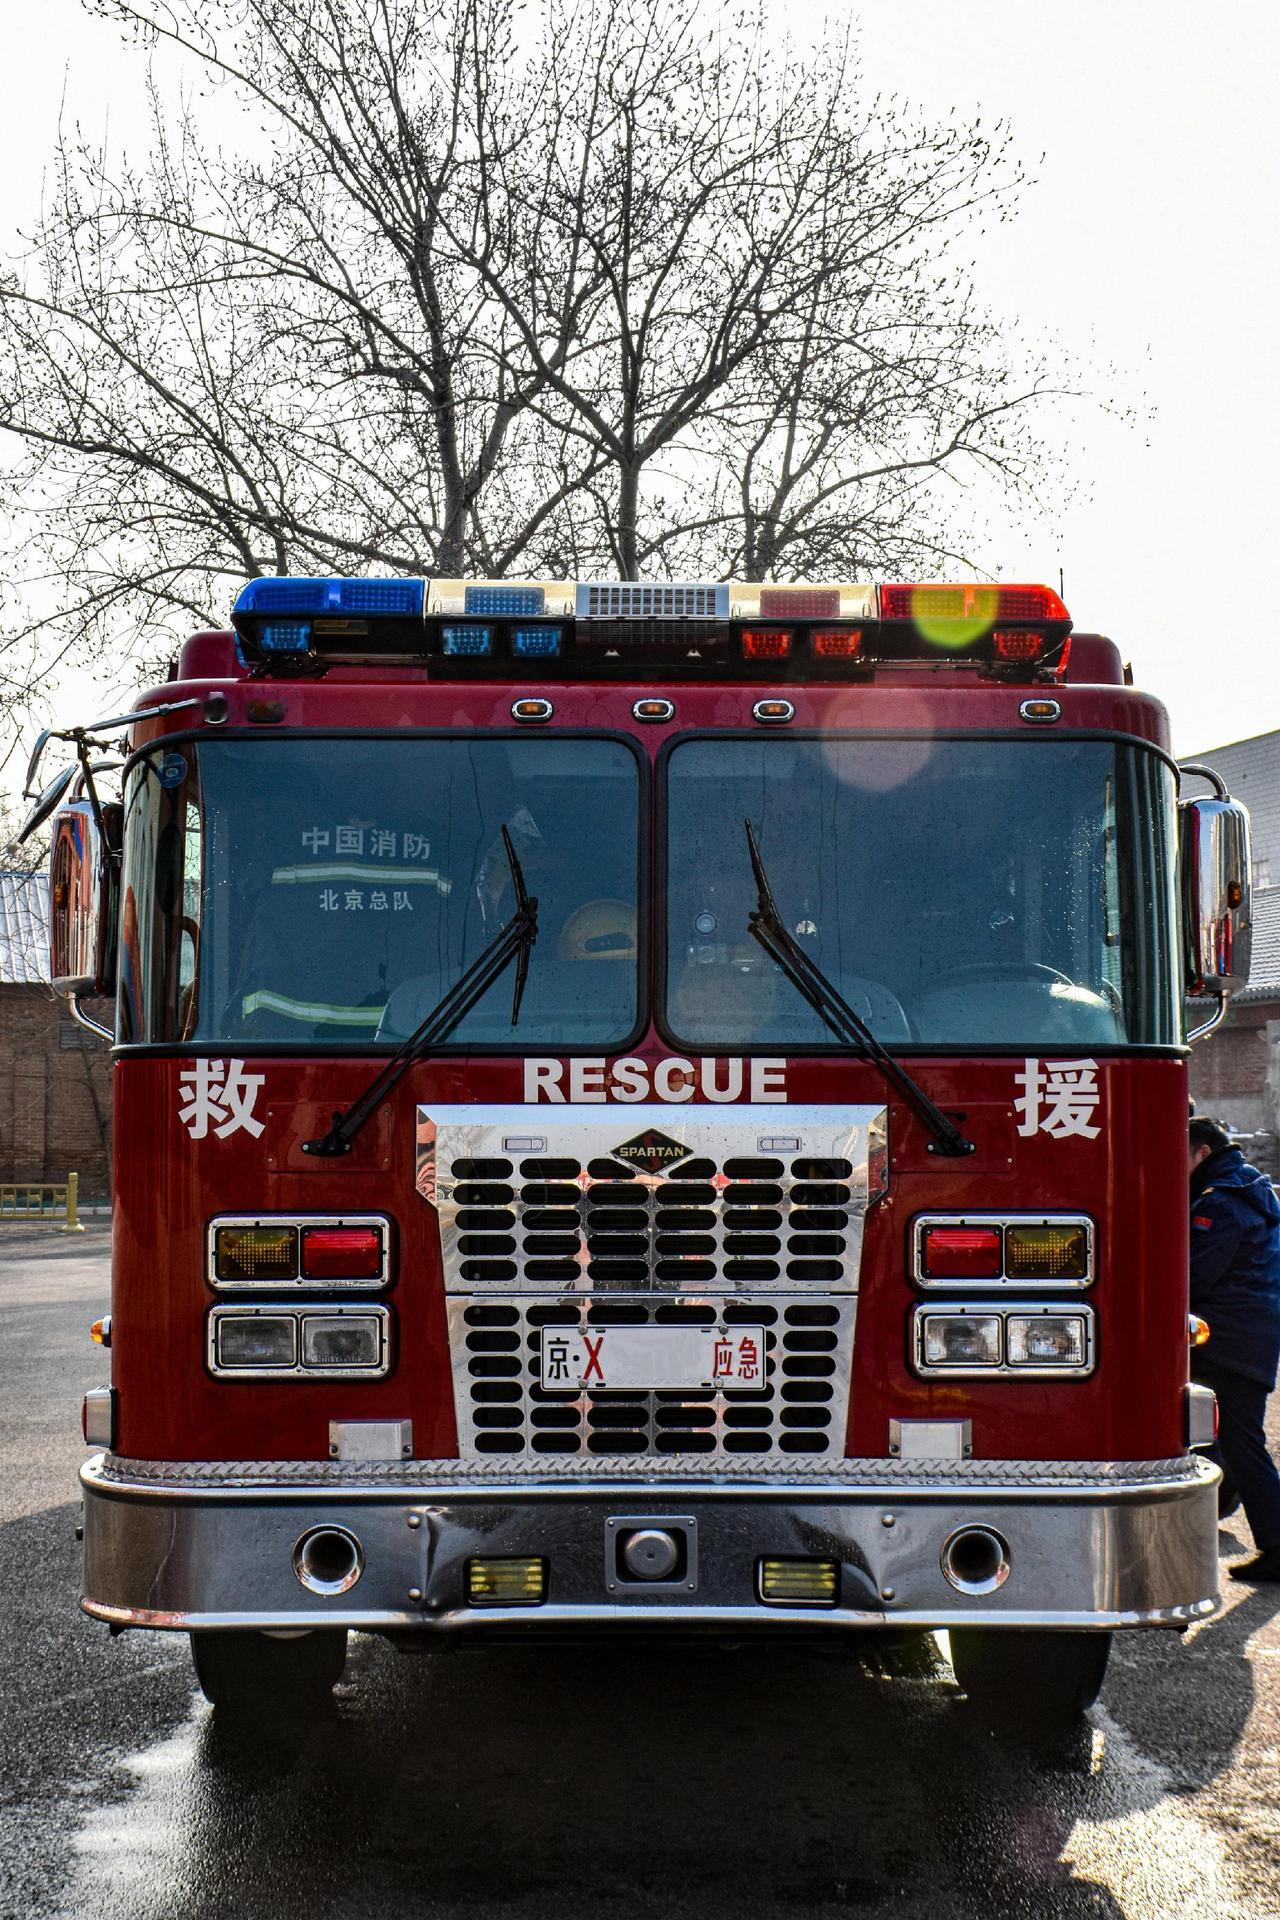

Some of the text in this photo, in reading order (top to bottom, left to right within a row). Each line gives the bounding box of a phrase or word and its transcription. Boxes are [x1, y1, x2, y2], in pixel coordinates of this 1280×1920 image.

[302, 825, 430, 859] 中国消防
[319, 889, 413, 911] 北京总队
[178, 1058, 266, 1139] 救
[524, 1057, 787, 1103] RESCUE
[1013, 1058, 1102, 1139] 援
[620, 1147, 684, 1156] SPARTAN
[713, 1336, 759, 1379] 应急
